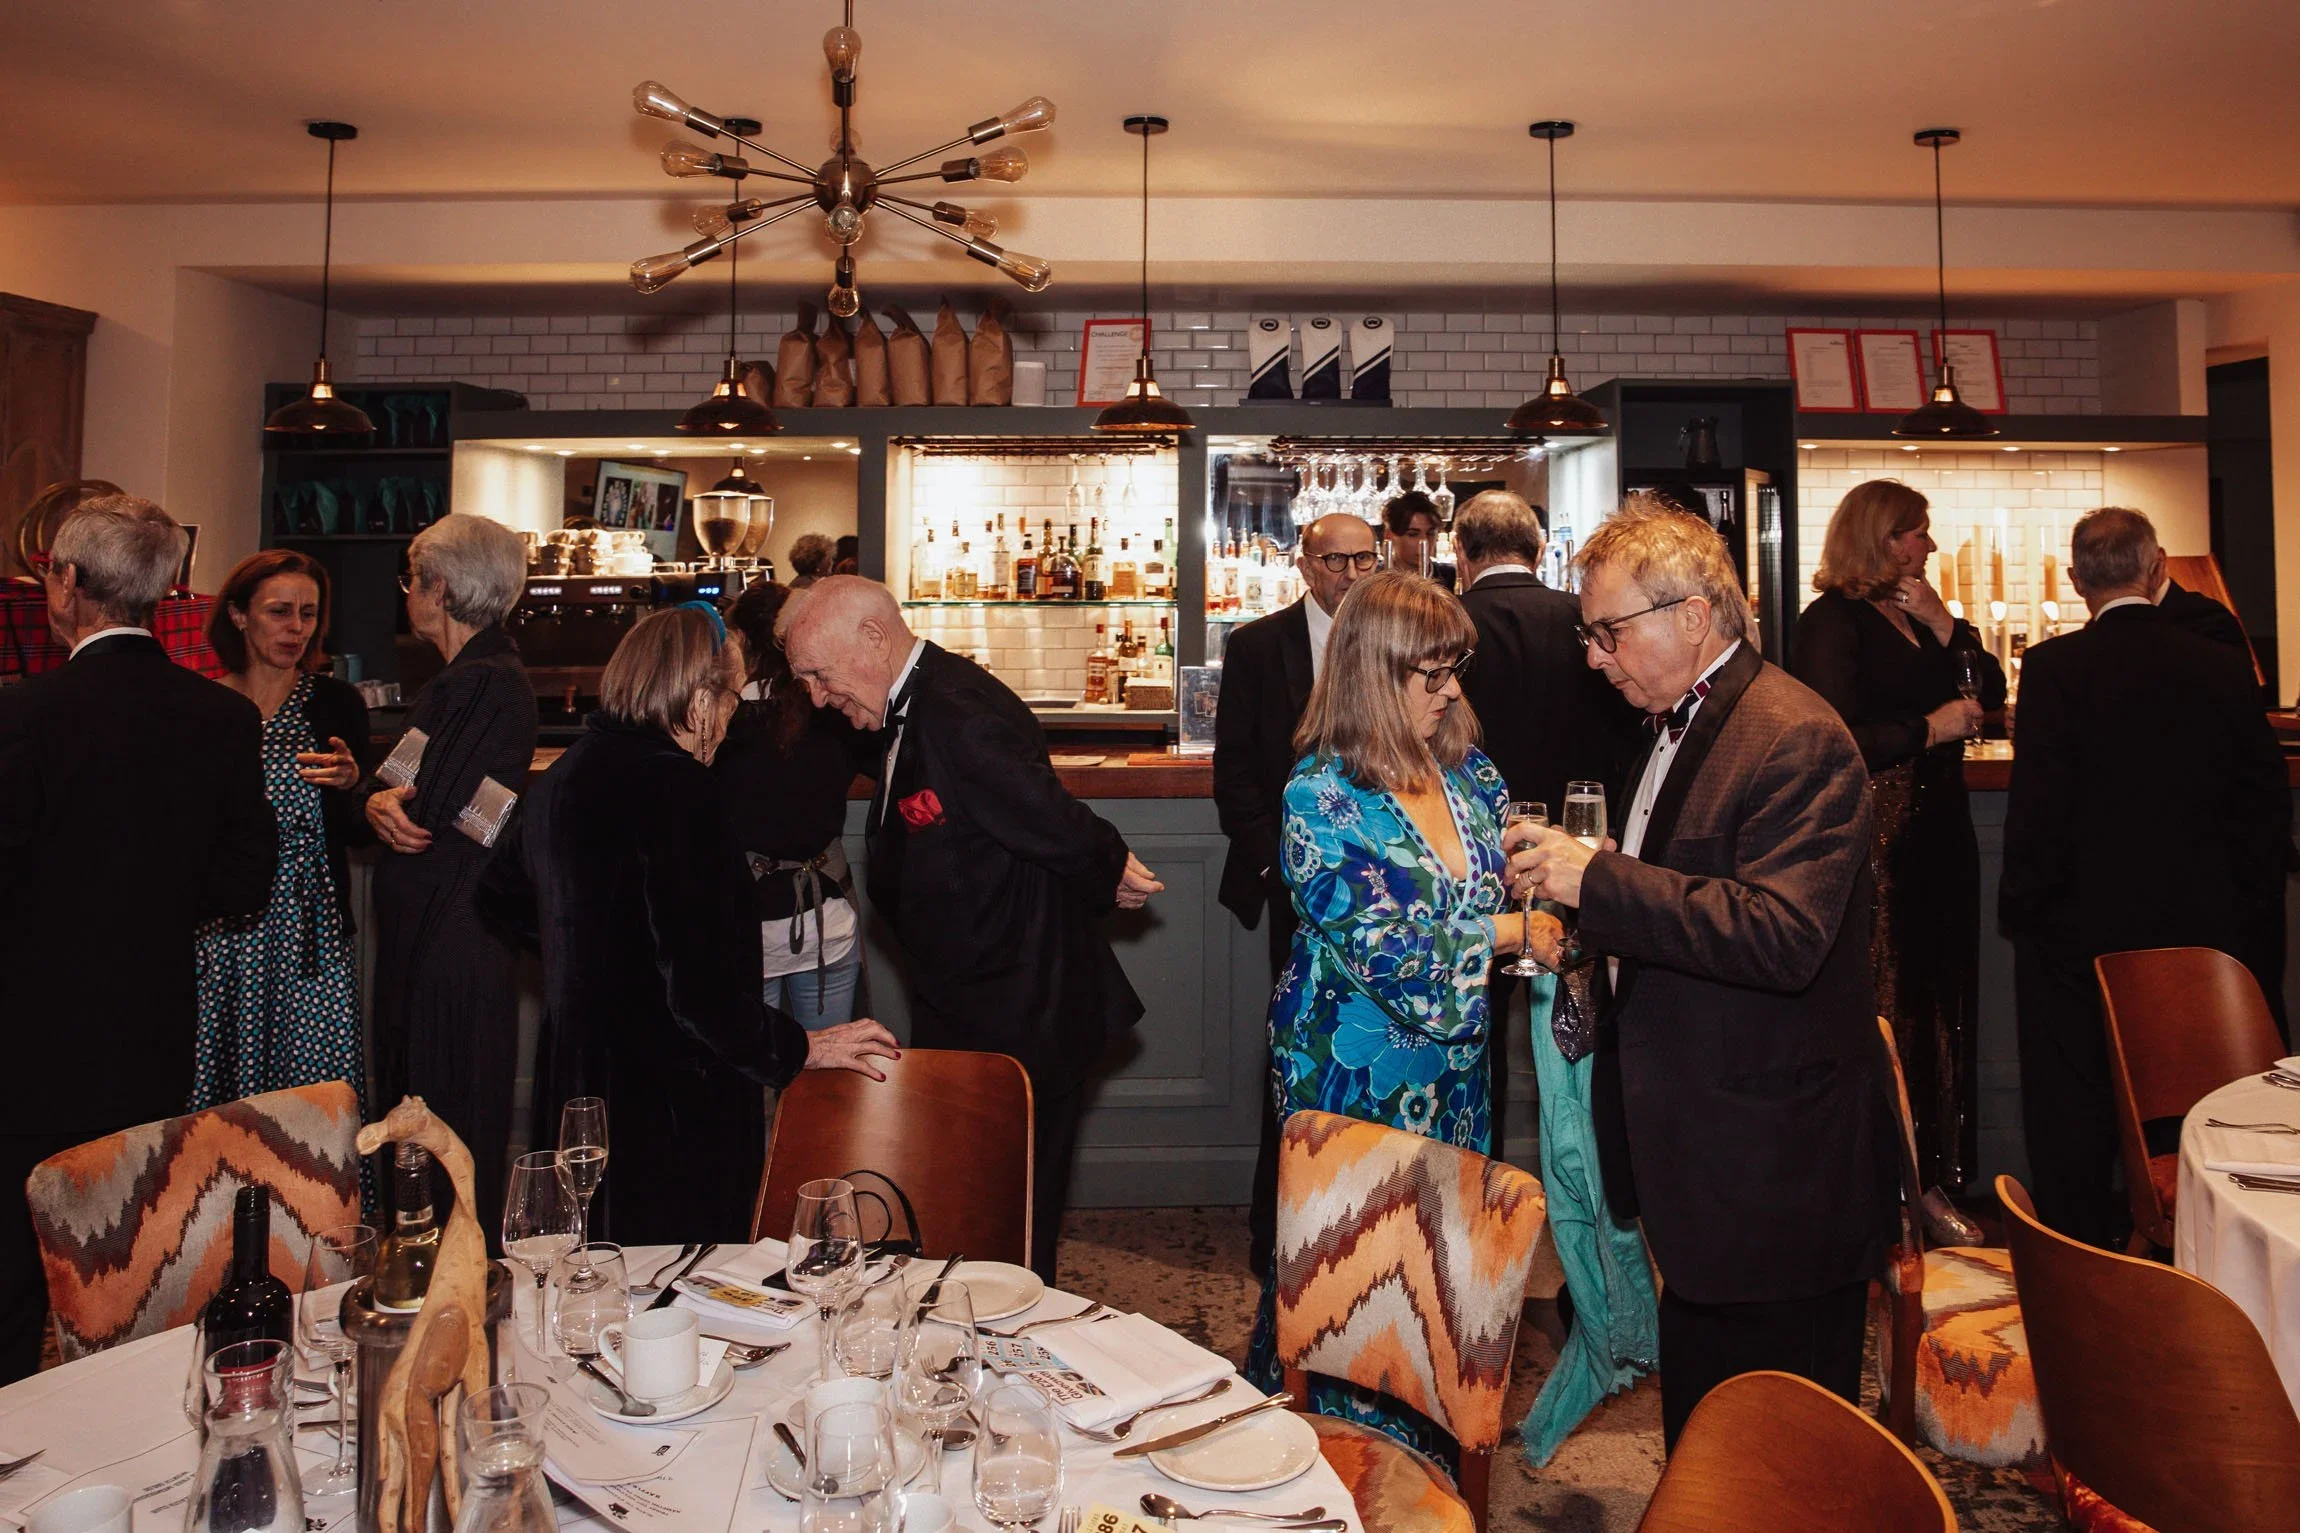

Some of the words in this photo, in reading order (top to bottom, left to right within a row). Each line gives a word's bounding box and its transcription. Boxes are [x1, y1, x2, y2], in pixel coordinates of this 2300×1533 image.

[1091, 330, 1128, 338] CHALLENGE
[985, 1340, 999, 1356] 256
[1011, 1343, 1025, 1358] 257
[1051, 1388, 1071, 1401] The
[1096, 1513, 1119, 1533] 86
